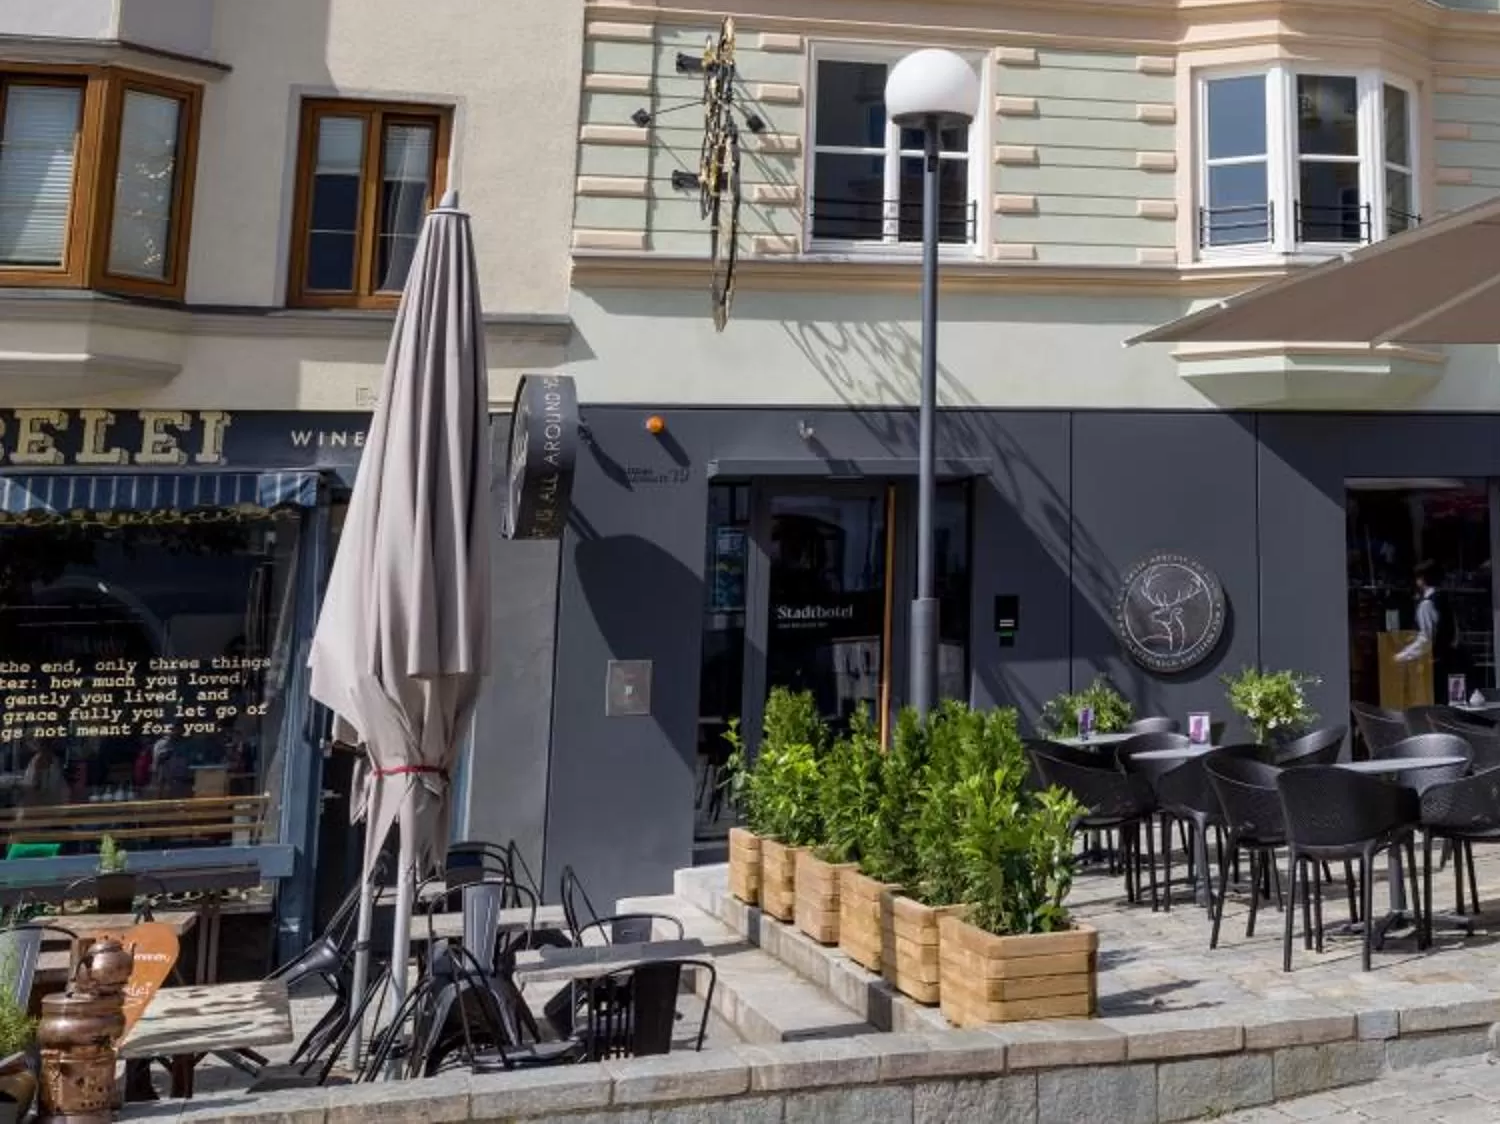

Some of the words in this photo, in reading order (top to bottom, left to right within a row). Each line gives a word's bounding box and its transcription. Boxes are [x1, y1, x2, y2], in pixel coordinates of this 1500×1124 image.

[0, 410, 231, 465] ELEI
[291, 430, 366, 447] WINE
[543, 392, 561, 466] AROUND
[540, 473, 559, 503] ALL
[777, 604, 853, 619] Stadthotel
[0, 660, 31, 673] the
[40, 660, 82, 675] end,
[95, 658, 137, 673] only
[150, 657, 200, 670] three
[211, 656, 272, 670] things
[50, 676, 83, 689] how
[92, 675, 136, 687] much
[146, 677, 178, 688] you
[188, 673, 248, 685] loved,
[4, 691, 70, 709] gently
[80, 693, 113, 707] you
[124, 690, 184, 703] lived,
[196, 689, 229, 701] and
[3, 711, 58, 726] grace
[69, 707, 122, 721] fully
[132, 708, 165, 721] you
[175, 705, 207, 717] let
[216, 707, 237, 719] go
[247, 703, 269, 715] of
[33, 726, 68, 737] not
[76, 724, 132, 736] meant
[142, 722, 173, 734] for
[182, 722, 223, 737] you.
